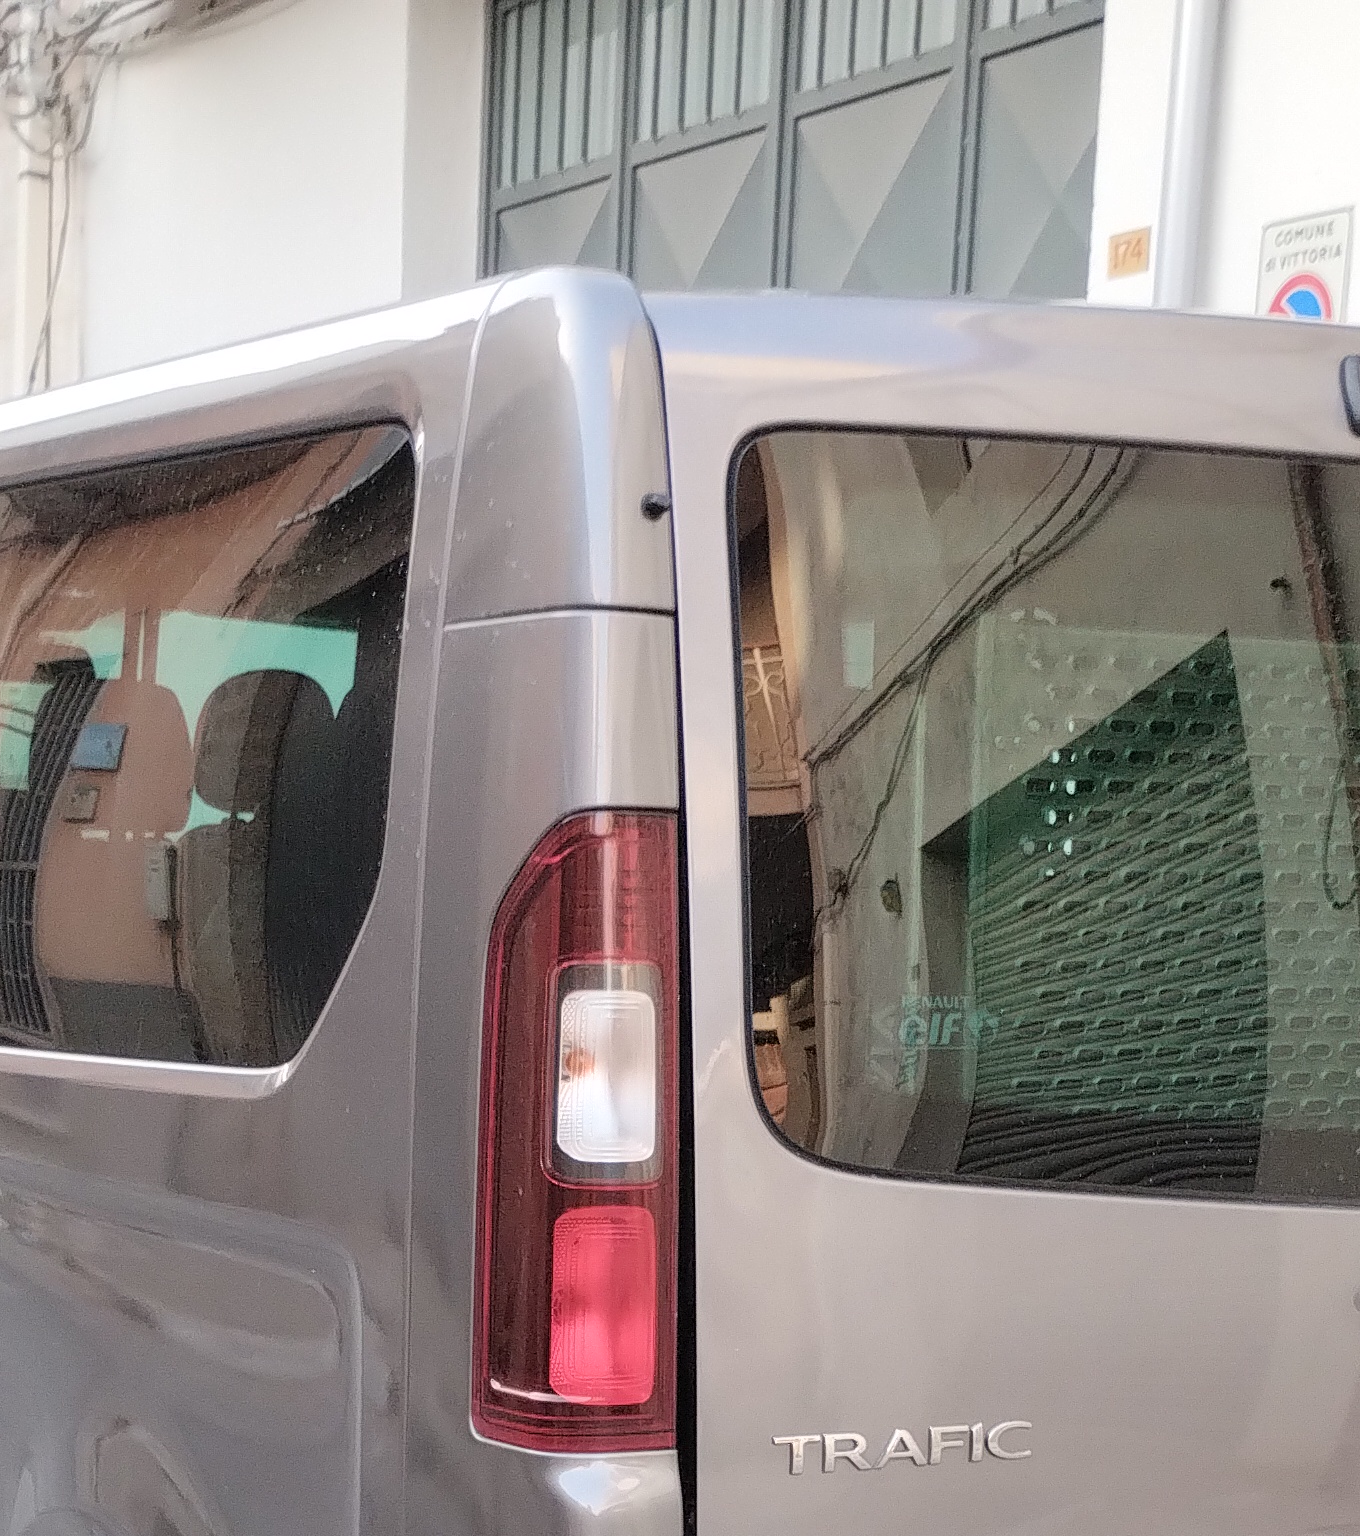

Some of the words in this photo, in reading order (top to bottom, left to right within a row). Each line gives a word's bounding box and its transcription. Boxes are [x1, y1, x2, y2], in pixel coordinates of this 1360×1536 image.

[1274, 220, 1335, 248] COMUNE
[1113, 236, 1143, 270] 174
[1280, 243, 1343, 271] VITTORIA
[771, 1420, 1033, 1476] TRAFIC
